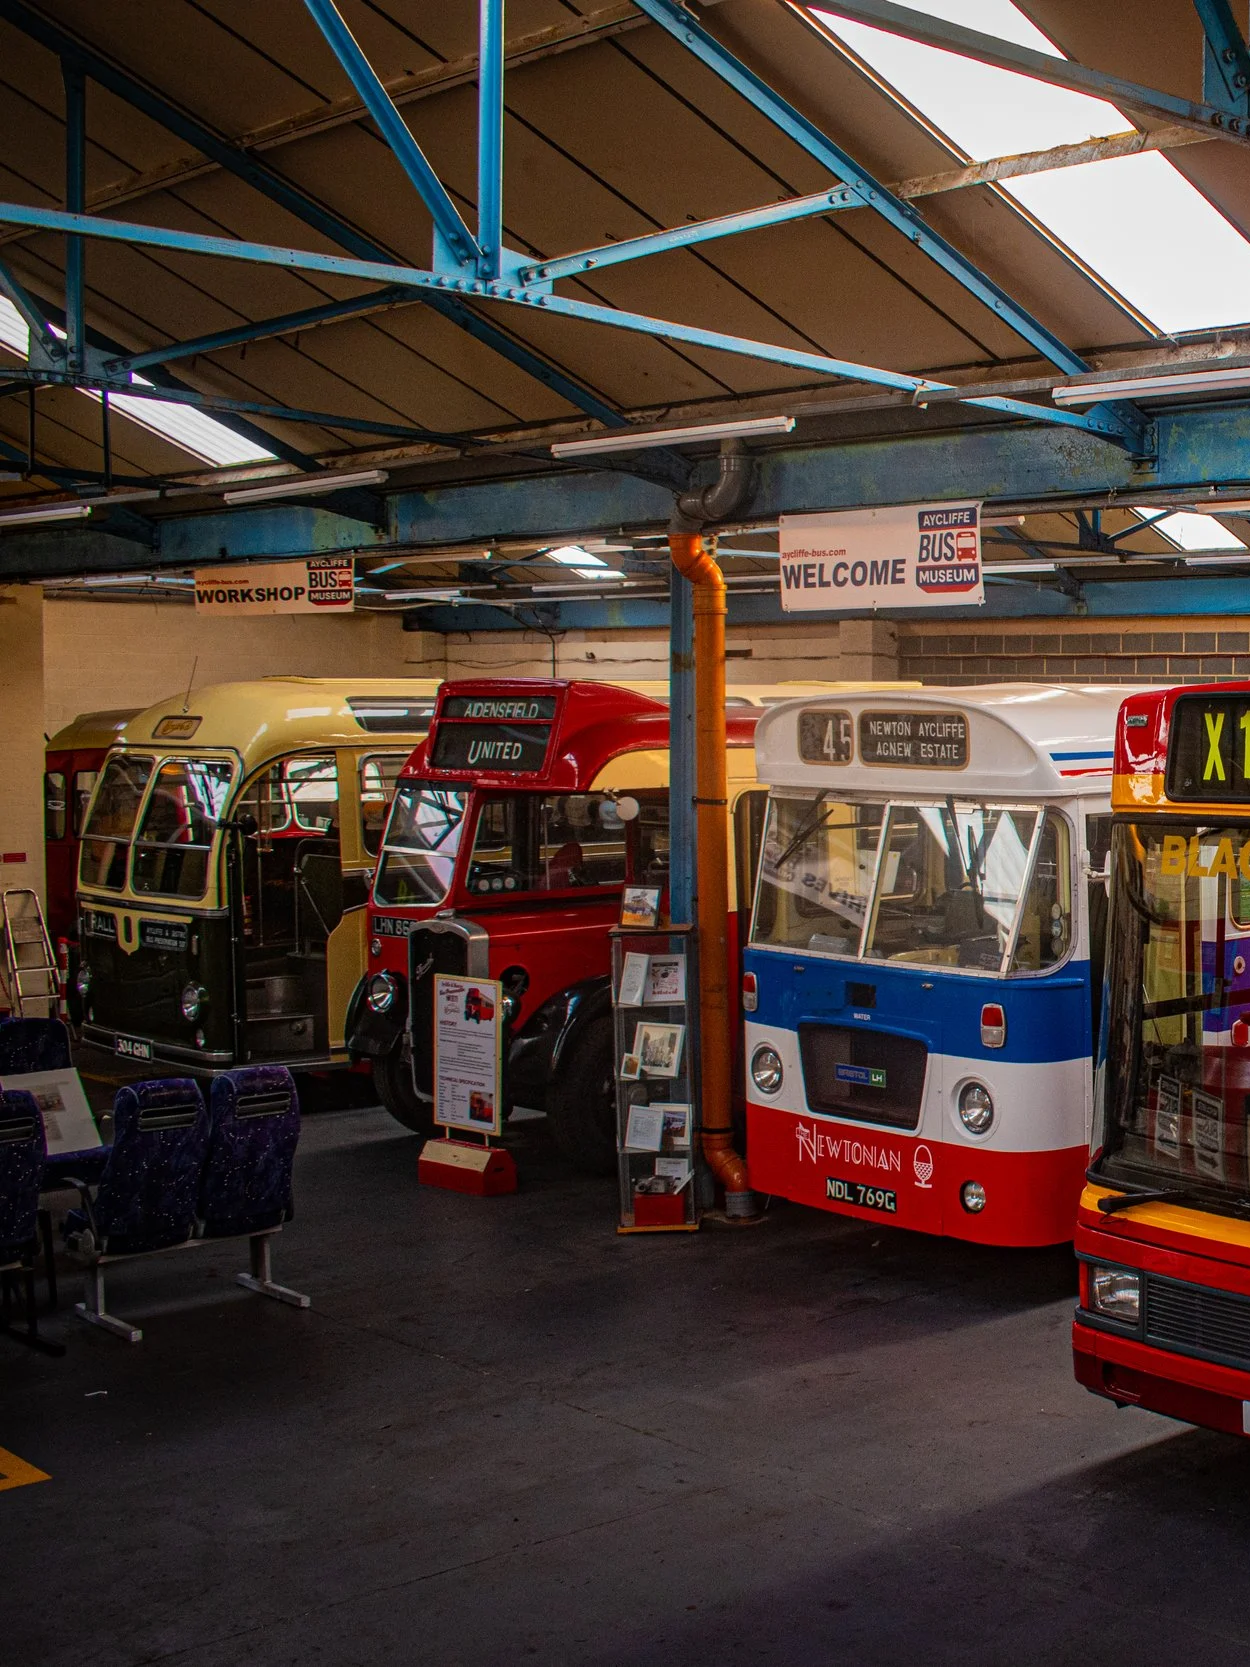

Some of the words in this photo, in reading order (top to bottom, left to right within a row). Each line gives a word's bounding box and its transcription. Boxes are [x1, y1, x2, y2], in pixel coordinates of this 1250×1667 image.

[922, 511, 971, 527] AYCLIFFE
[782, 548, 847, 560] aycliffe-bus.com
[918, 532, 956, 563] BUS
[310, 559, 349, 568] AYCLIFFE
[308, 571, 338, 588] BUS
[782, 558, 907, 590] WELCOME
[919, 568, 976, 584] MUSEUM
[196, 586, 306, 604] WORKSHOP
[310, 591, 351, 600] MUSEUM
[464, 702, 539, 718] AIDENSFIELD
[869, 720, 911, 737] NEWTON
[918, 722, 965, 738] AYCLIFFE
[467, 740, 523, 764] UNITED
[876, 741, 912, 757] AGNEW
[920, 743, 959, 759] ESTATE
[871, 1073, 883, 1082] LH
[798, 1122, 901, 1172] NEWTONIAN
[826, 1179, 853, 1201] NDL
[857, 1184, 896, 1212] 769G
